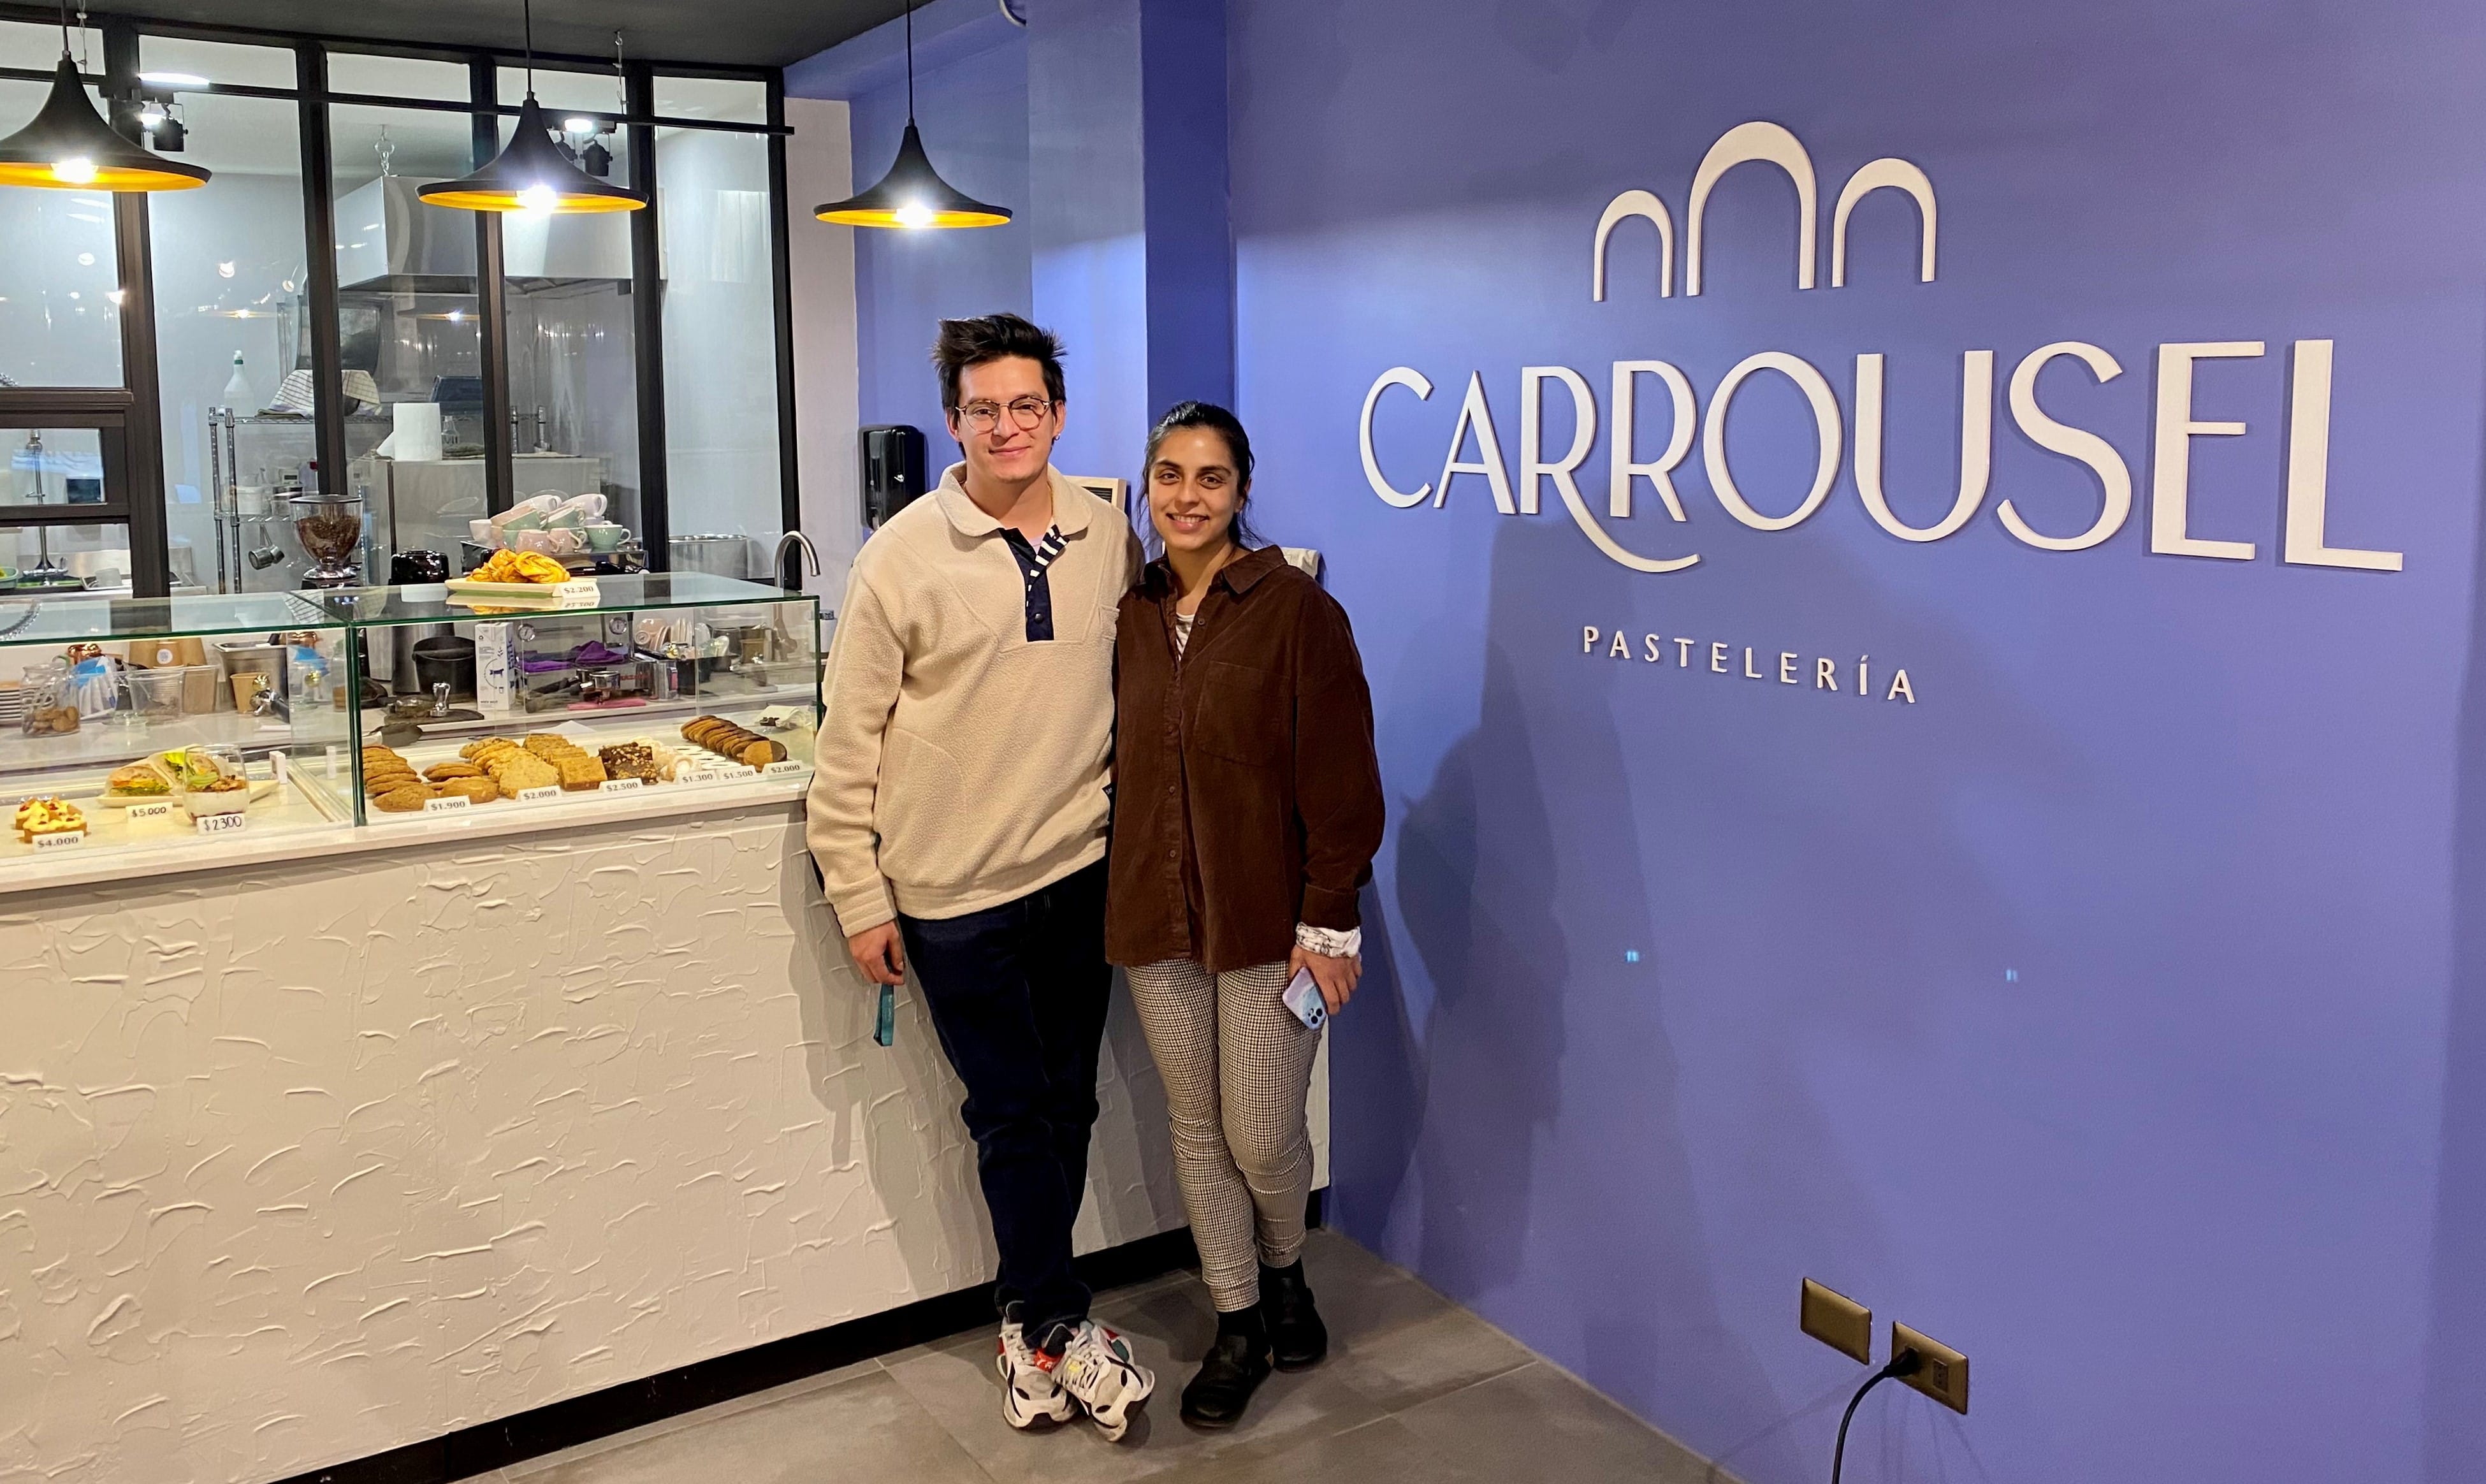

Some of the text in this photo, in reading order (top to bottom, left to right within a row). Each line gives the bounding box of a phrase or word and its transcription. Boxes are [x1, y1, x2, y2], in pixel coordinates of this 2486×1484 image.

[1360, 340, 2403, 572] CARROUSEL
[1584, 626, 1915, 704] PASTELERÍA
[771, 764, 801, 774] $2.000
[606, 782, 639, 792] $2.500
[523, 790, 556, 800] $2.000
[430, 801, 465, 811] $1.900
[38, 836, 78, 848] $4.000
